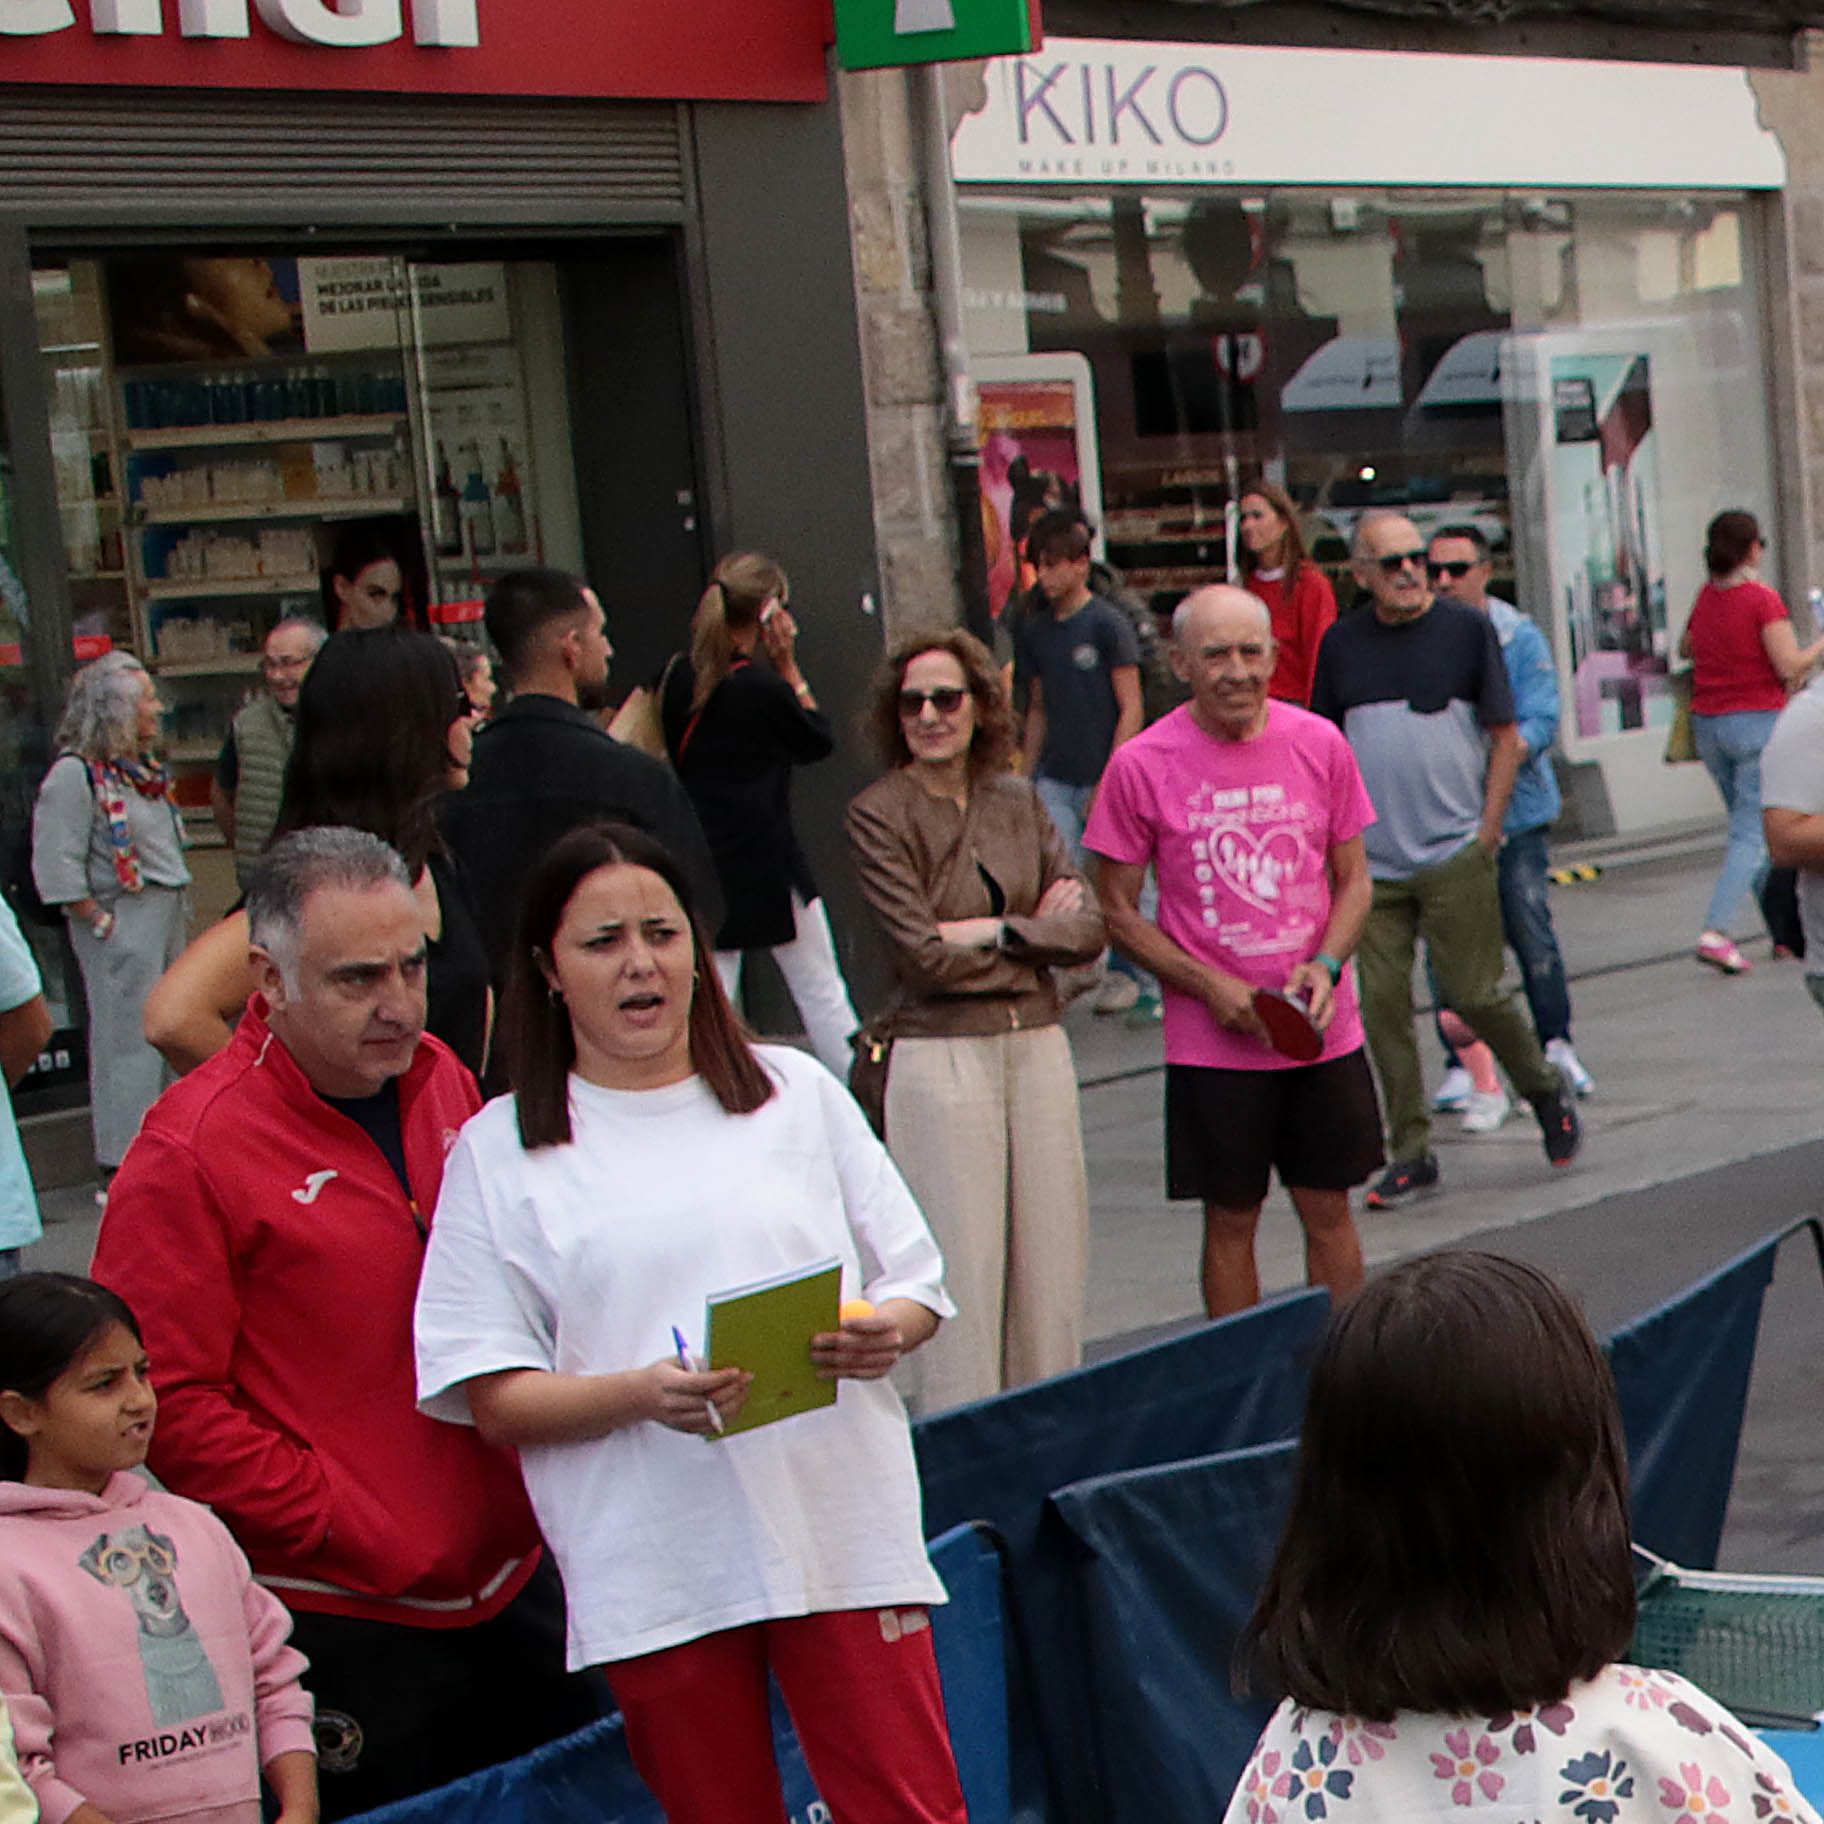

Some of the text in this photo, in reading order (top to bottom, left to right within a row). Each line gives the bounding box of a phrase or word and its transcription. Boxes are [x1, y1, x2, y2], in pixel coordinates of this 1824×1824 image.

[1014, 61, 1228, 145] KIKO
[1018, 159, 1236, 175] MAKE UP MILANO
[118, 1724, 207, 1766] FRIDAY
